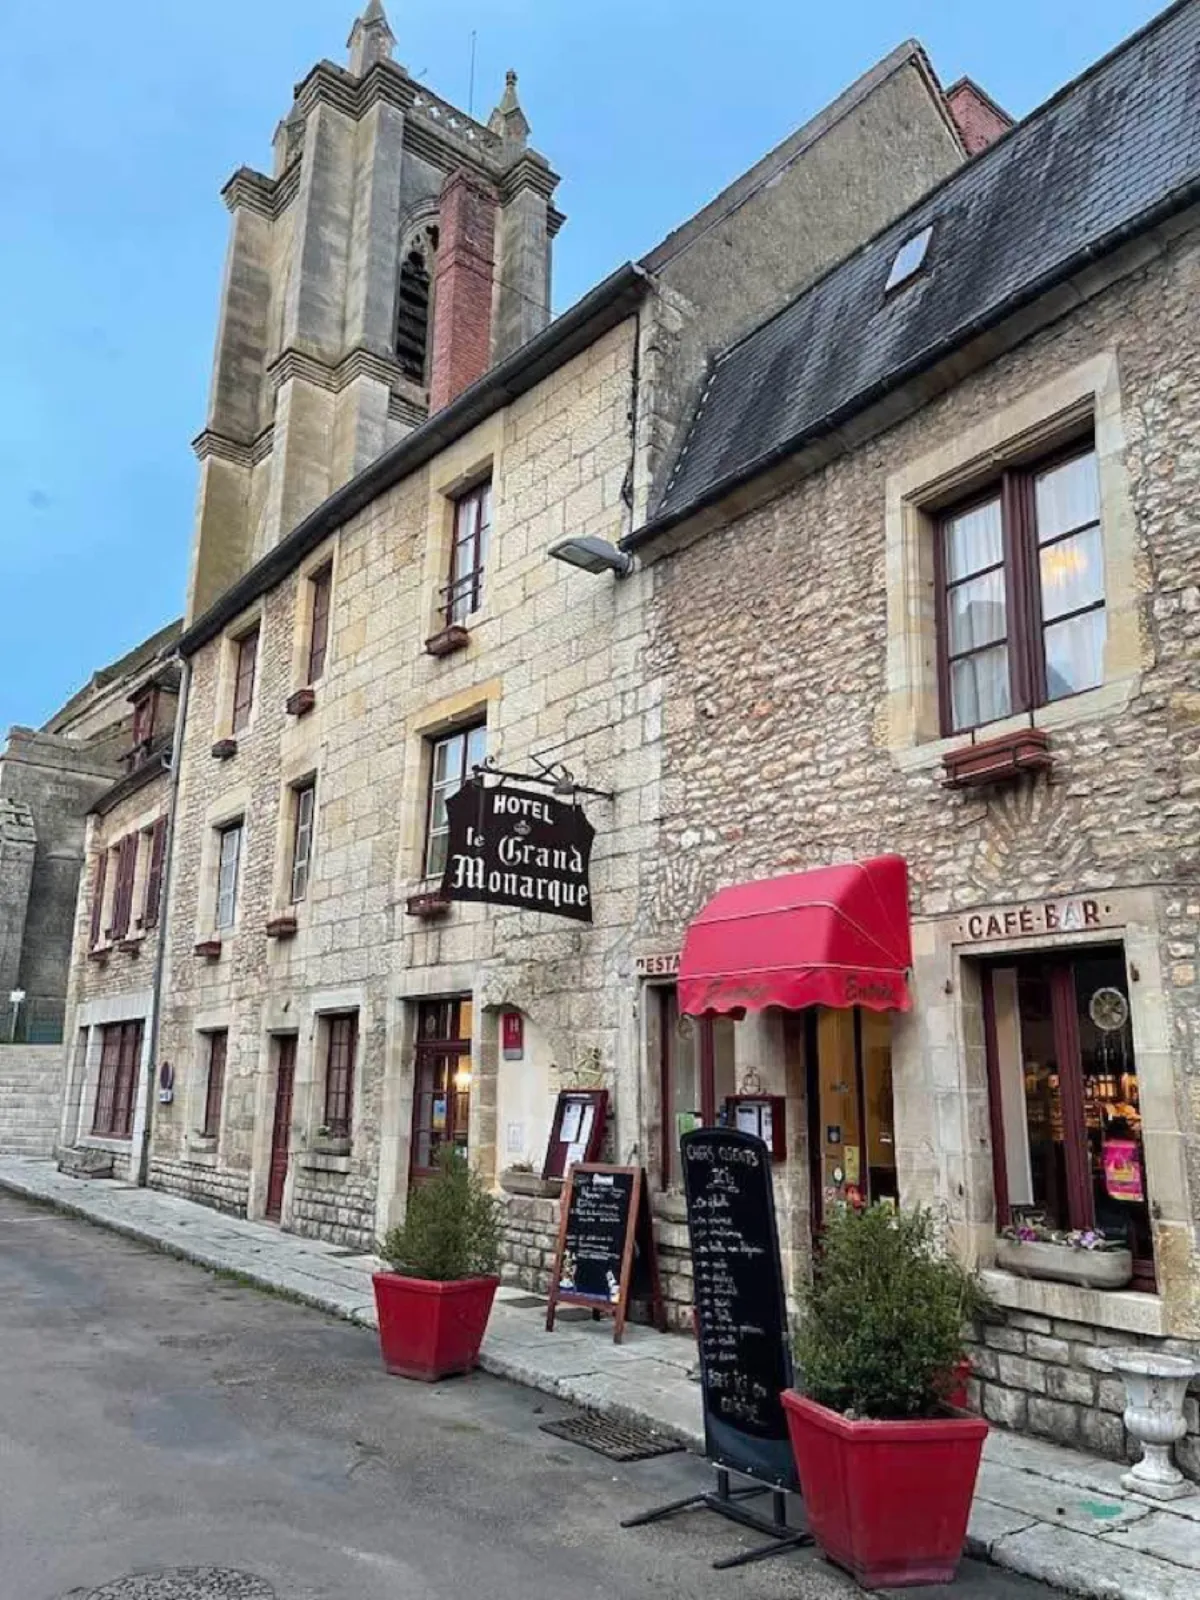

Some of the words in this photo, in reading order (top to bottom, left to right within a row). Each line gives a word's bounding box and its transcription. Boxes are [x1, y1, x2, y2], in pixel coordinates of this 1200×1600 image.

[493, 794, 554, 825] HOTEL
[466, 826, 486, 848] le
[498, 835, 583, 874] Grand
[452, 855, 589, 908] Monarque
